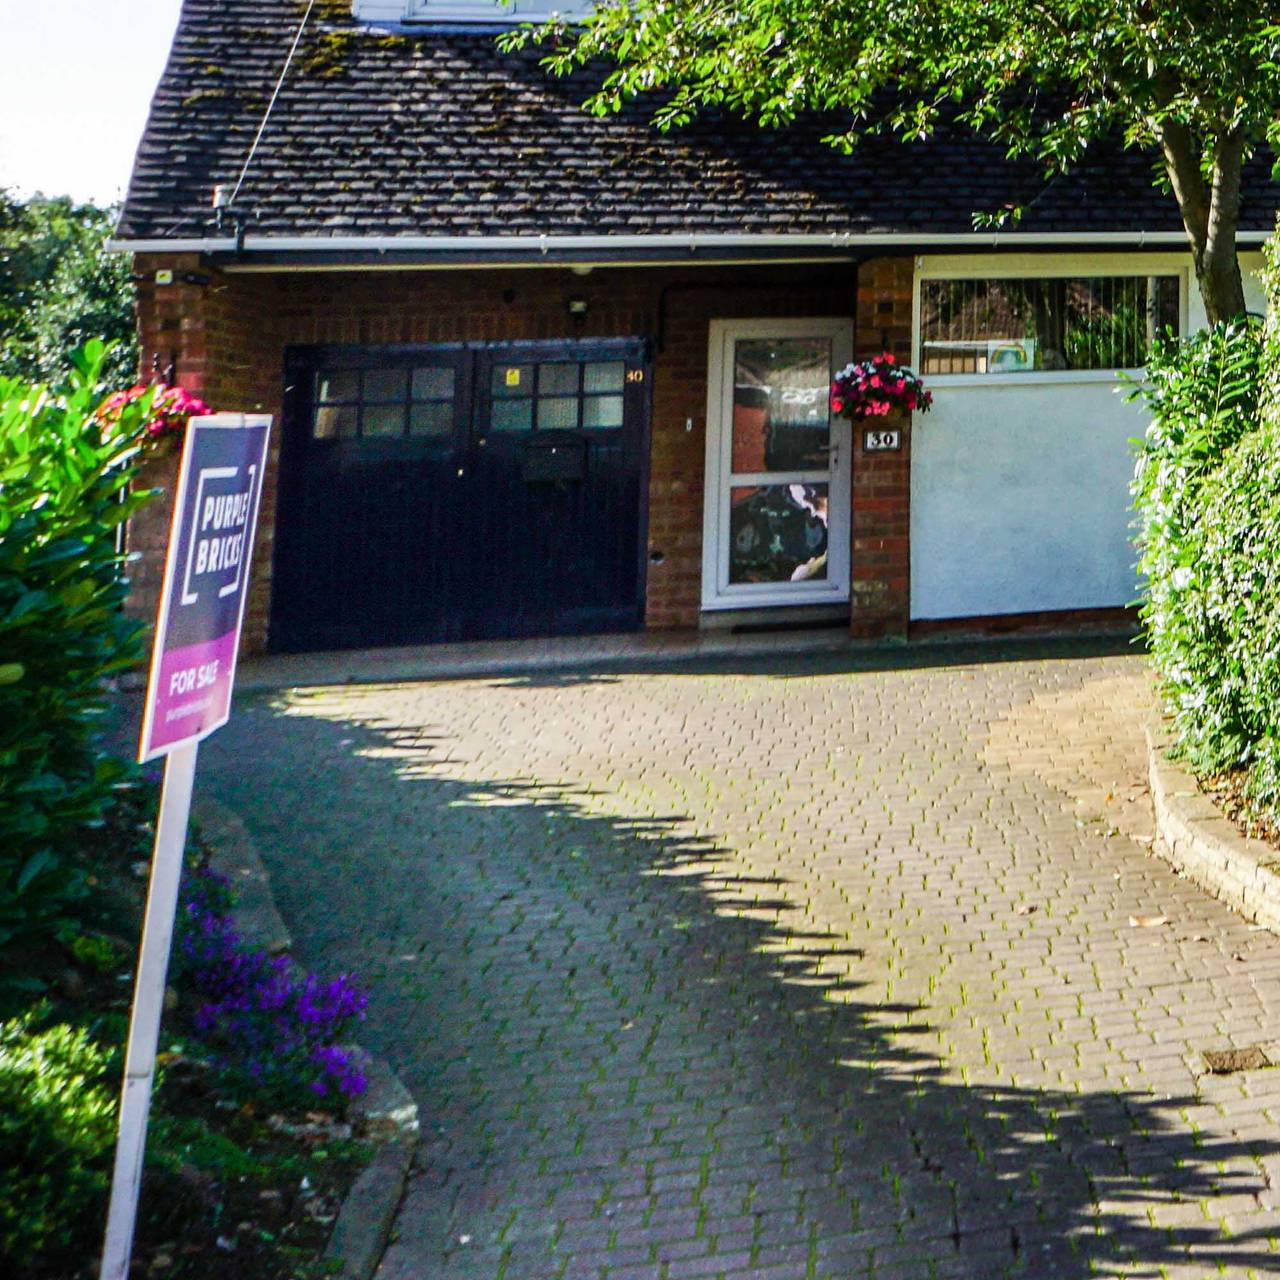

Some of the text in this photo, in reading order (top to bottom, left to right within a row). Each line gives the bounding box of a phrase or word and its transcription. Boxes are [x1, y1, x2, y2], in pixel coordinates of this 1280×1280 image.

[871, 431, 894, 448] 30
[202, 492, 248, 531] PURPLE
[196, 533, 242, 575] BRICKS
[169, 659, 219, 696] FOR SALE
